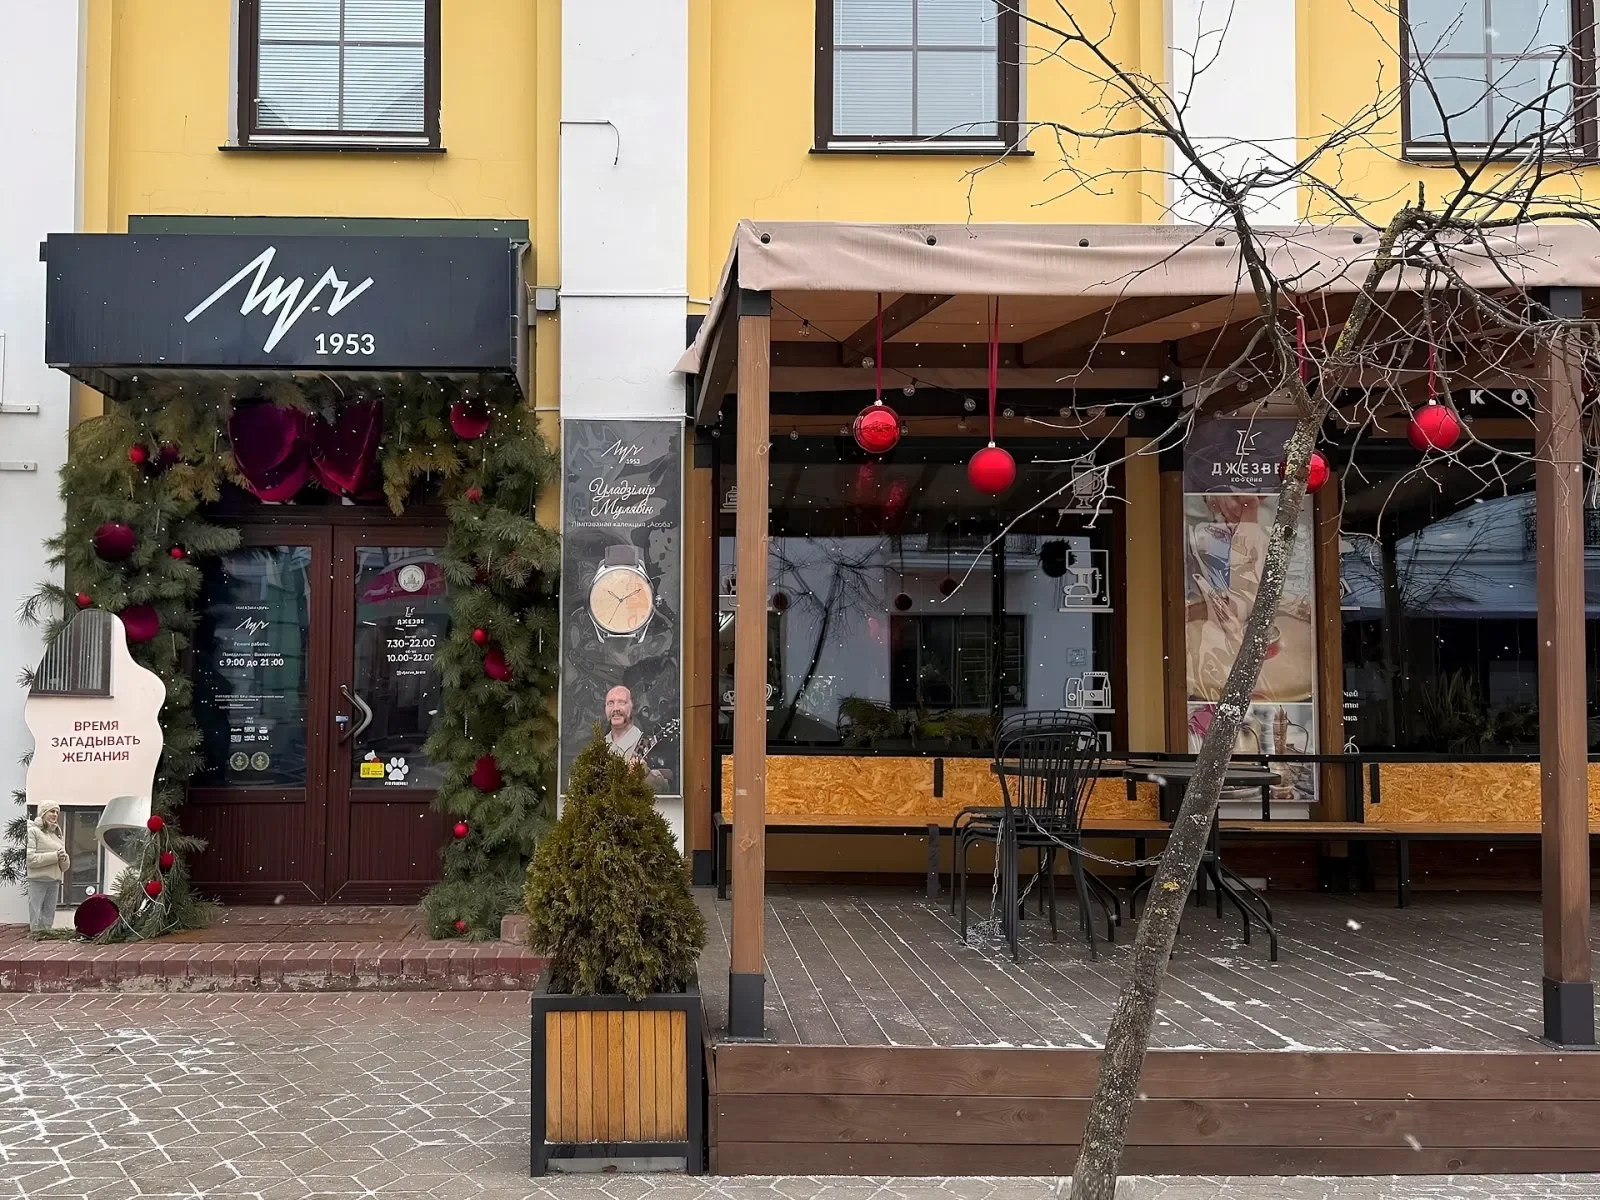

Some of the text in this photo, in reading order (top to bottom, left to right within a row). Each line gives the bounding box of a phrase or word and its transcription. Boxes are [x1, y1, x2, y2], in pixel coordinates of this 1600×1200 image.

[314, 333, 376, 355] 1953
[226, 658, 245, 667] 9:00
[246, 660, 258, 668] до
[74, 720, 119, 731] ВРЕМЯ
[51, 735, 141, 748] ЗАГАДЫВАТЬ
[62, 751, 129, 762] ЖЕЛАНИЯ
